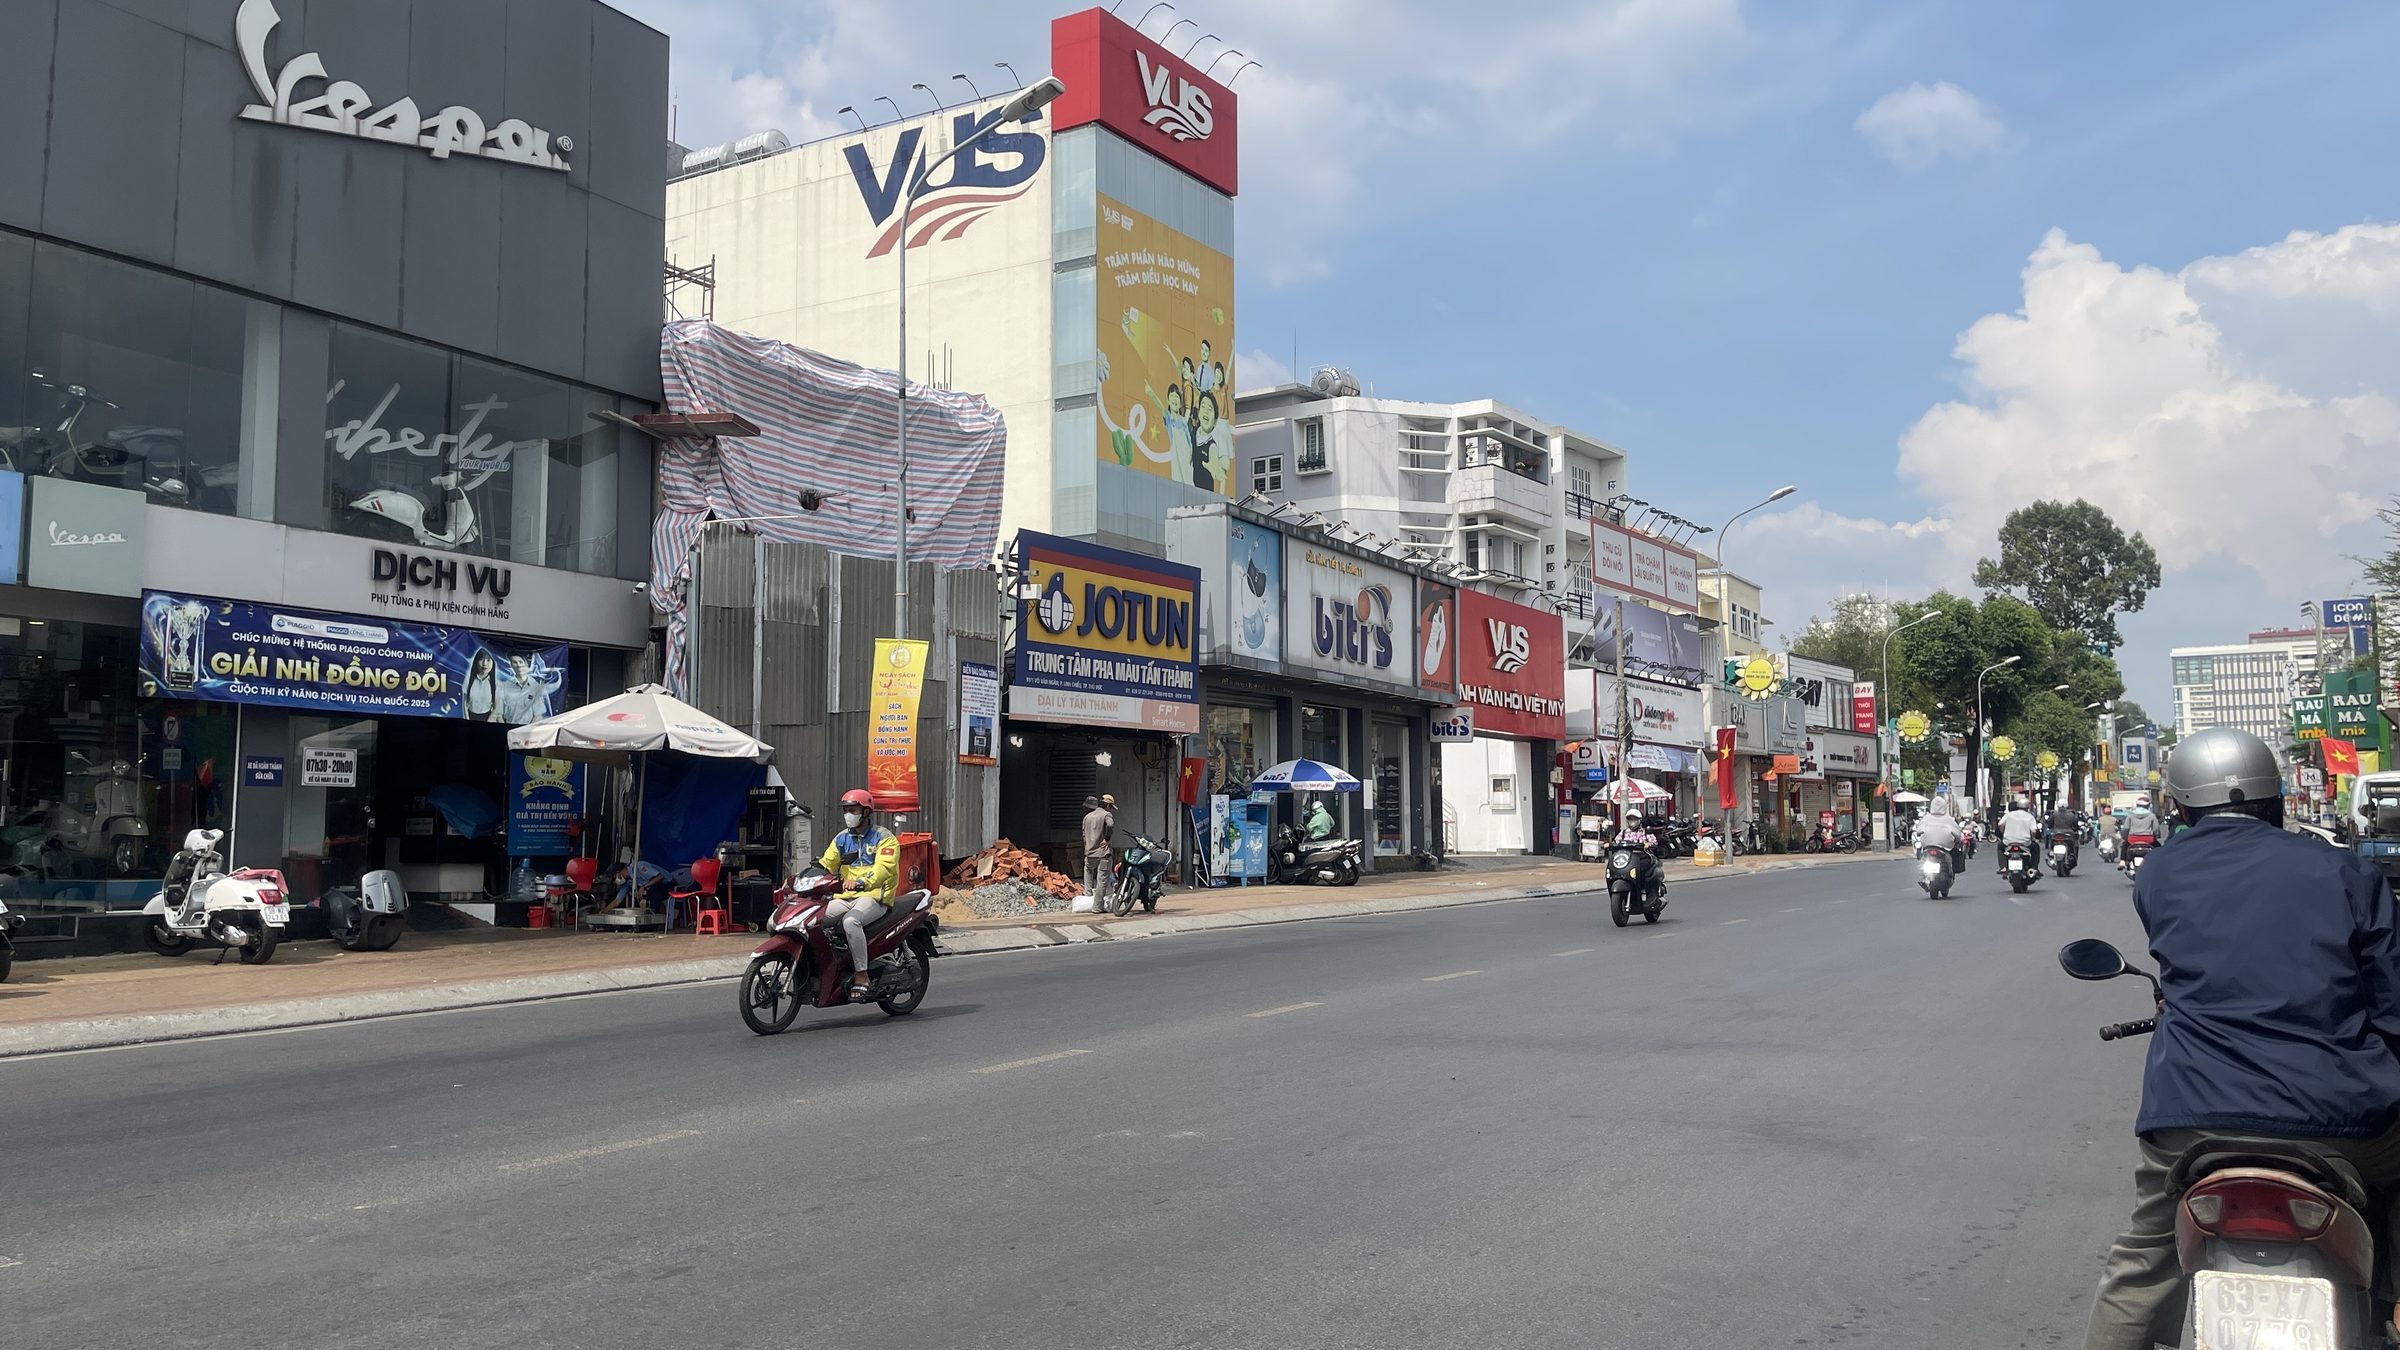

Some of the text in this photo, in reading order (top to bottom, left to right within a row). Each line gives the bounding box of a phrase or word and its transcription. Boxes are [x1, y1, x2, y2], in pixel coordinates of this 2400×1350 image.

[235, 0, 571, 172] Vespa
[1135, 49, 1213, 135] VUS
[842, 103, 1046, 229] VUS
[1163, 273, 1179, 290] HỌC
[1182, 279, 1199, 295] HAY
[459, 459, 510, 471] YOUR WORLD
[48, 520, 127, 546] Vespa
[1602, 542, 1614, 554] THU
[373, 550, 511, 605] DỊCH VỤ
[371, 592, 509, 620] PHỤ TÙNG & PHỤ KIỆN CHÍNH HÀNG
[2333, 603, 2364, 612] ICON
[1077, 583, 1189, 649] JOTUN
[327, 626, 349, 634] PIAGGIO
[1311, 592, 1393, 669] biti's
[1487, 618, 1530, 660] VUS
[232, 631, 432, 661] CHÚC MỪNG HỆ THỐNG PIAGGIO CÔNG THÀNH
[210, 648, 447, 696] GIẢI NHÌ ĐỒNG ĐỘI
[1026, 651, 1065, 675] TRUNG
[1066, 652, 1091, 678] TÂM
[1093, 659, 1114, 680] PHA
[1115, 659, 1140, 684] MÀU
[1141, 660, 1161, 686] TẤN
[1162, 665, 1193, 689] THÀNH
[229, 685, 430, 708] CUỘC THI KỸ NĂNG DỊCH VỤ TOÀN QUỐC 2025
[1855, 686, 1872, 694] BAY
[1038, 694, 1118, 712] ĐẠI LÝ TẤN THÀNH
[1478, 685, 1503, 707] VĂN
[1504, 690, 1523, 714] HỘI
[1523, 693, 1547, 717] VIỆT
[1548, 696, 1565, 716] MỸ
[2295, 699, 2323, 711] RAU
[2332, 694, 2372, 707] RAU
[1158, 705, 1180, 716] FPT
[2301, 711, 2322, 724] MÁ
[2338, 707, 2367, 723] MÁ
[1152, 718, 1185, 729] Smart Home
[1432, 719, 1469, 737] biti's
[2341, 725, 2366, 736] mix
[2299, 727, 2328, 739] mix
[306, 759, 353, 773] 07h30 20h00
